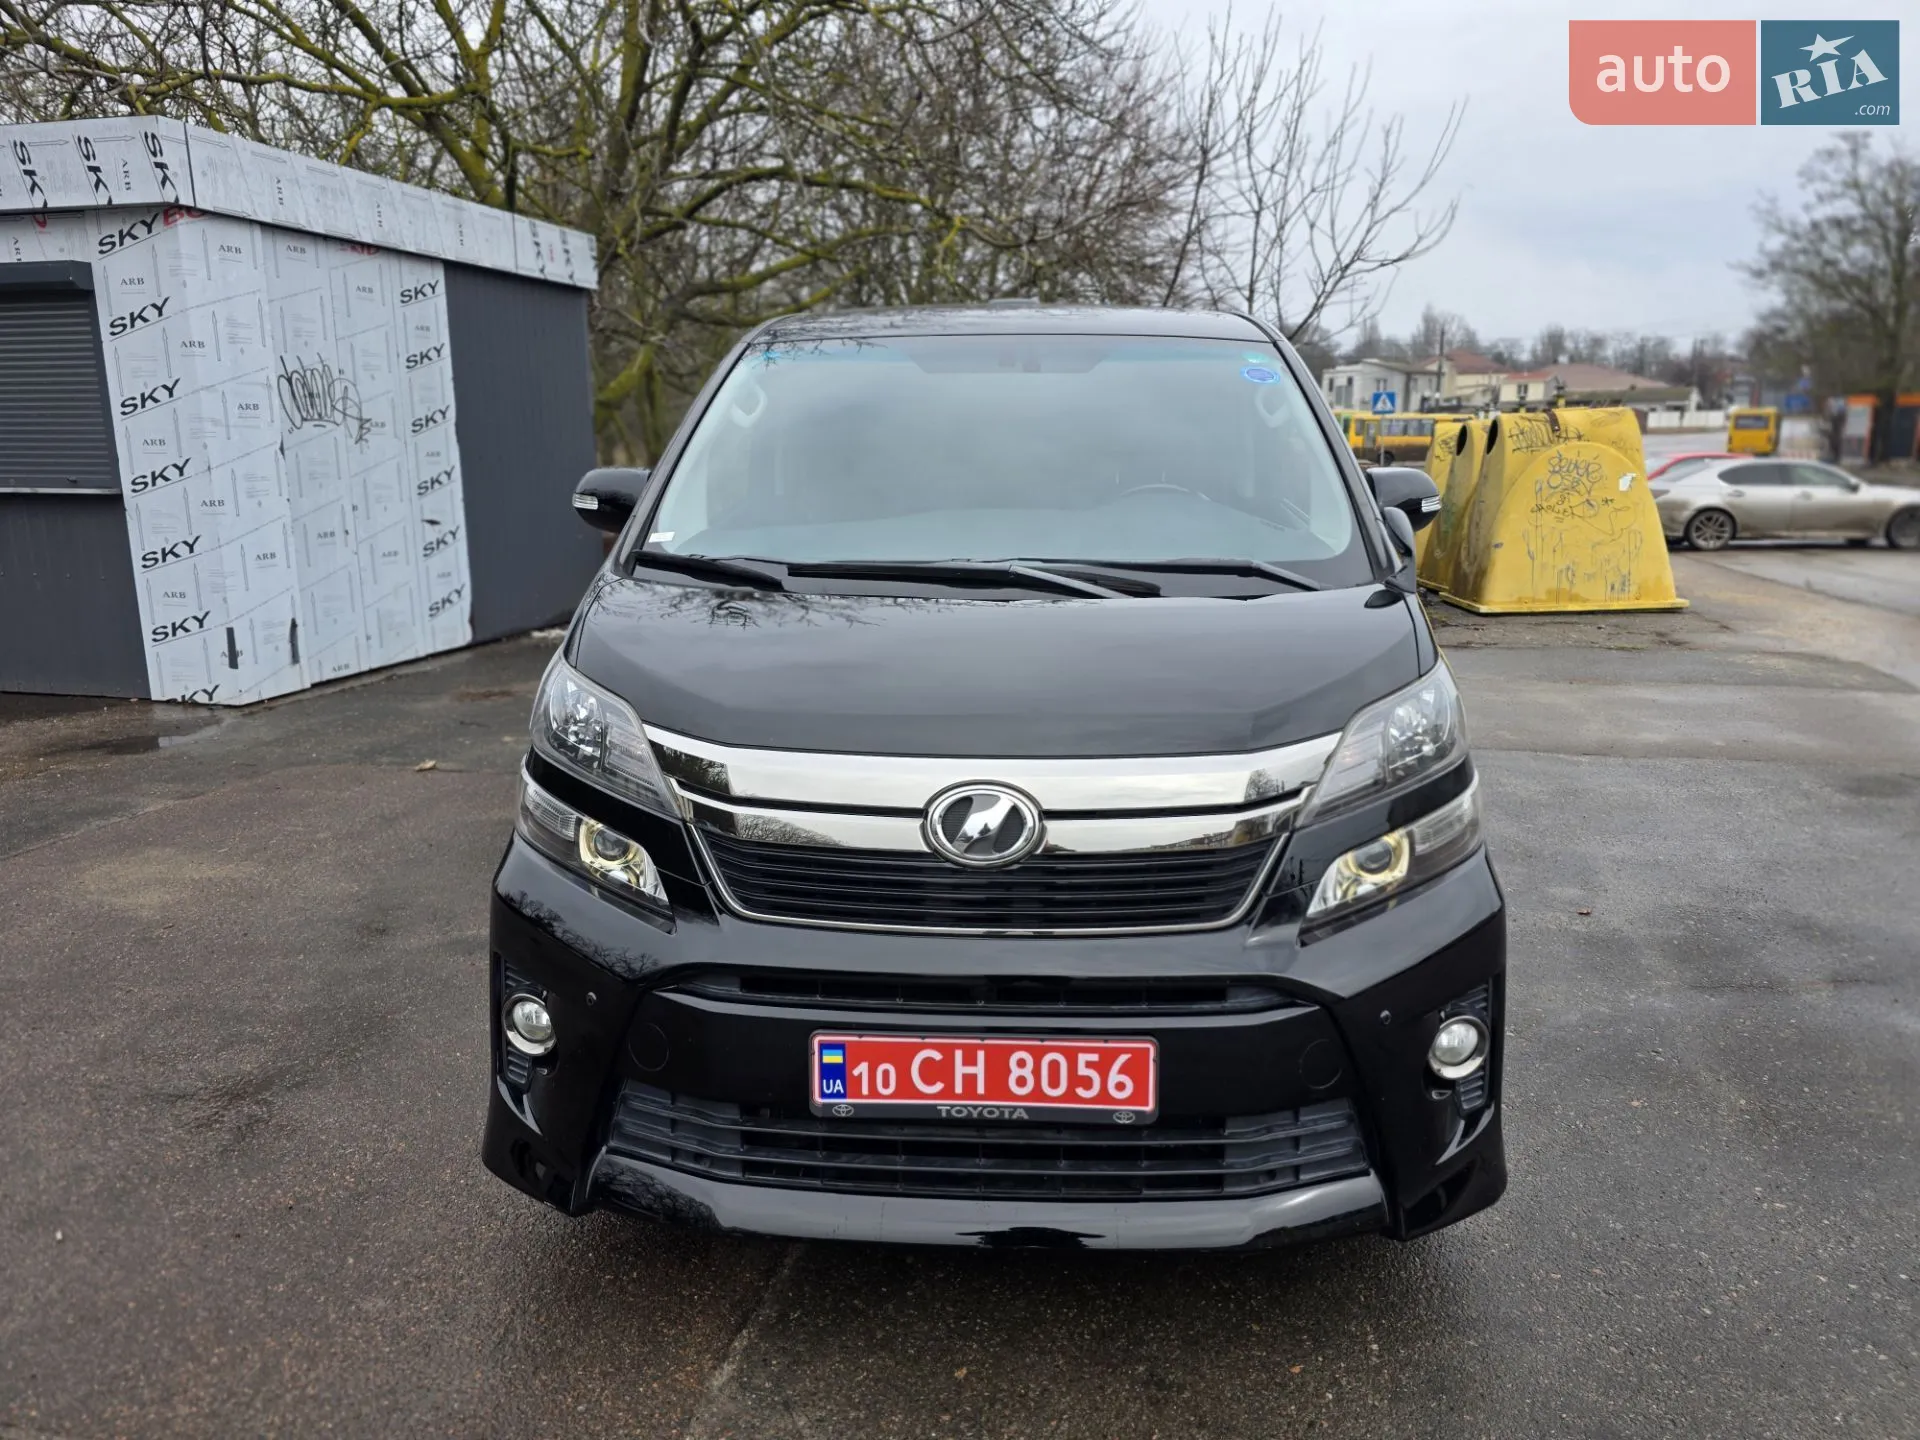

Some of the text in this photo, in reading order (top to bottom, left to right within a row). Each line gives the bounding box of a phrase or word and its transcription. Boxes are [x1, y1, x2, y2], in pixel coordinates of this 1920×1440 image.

[218, 244, 242, 255] ARB
[286, 244, 307, 254] ARB
[120, 277, 145, 286] ARB
[355, 284, 374, 294] ARB
[400, 279, 440, 305] SKY
[108, 296, 171, 337] SKY
[180, 340, 206, 349] ARB
[405, 342, 445, 370] SKY
[120, 377, 181, 416] SKY
[237, 402, 260, 411] ARB
[411, 404, 450, 434] SKY
[142, 438, 167, 447] ARB
[130, 456, 192, 494] SKY
[416, 465, 456, 497] SKY
[200, 499, 225, 508] ARB
[316, 531, 336, 540] ARB
[422, 525, 461, 558] SKY
[141, 534, 202, 570] SKY
[255, 551, 277, 561] ARB
[162, 591, 187, 599] ARB
[428, 584, 466, 618] SKY
[151, 610, 211, 643] SKY
[220, 649, 244, 658] AB
[332, 662, 350, 673] ARB
[166, 684, 221, 704] KY
[851, 1049, 1134, 1100] 10 CH 8056
[822, 1079, 844, 1094] UA
[936, 1105, 1030, 1120] TOYOTA
